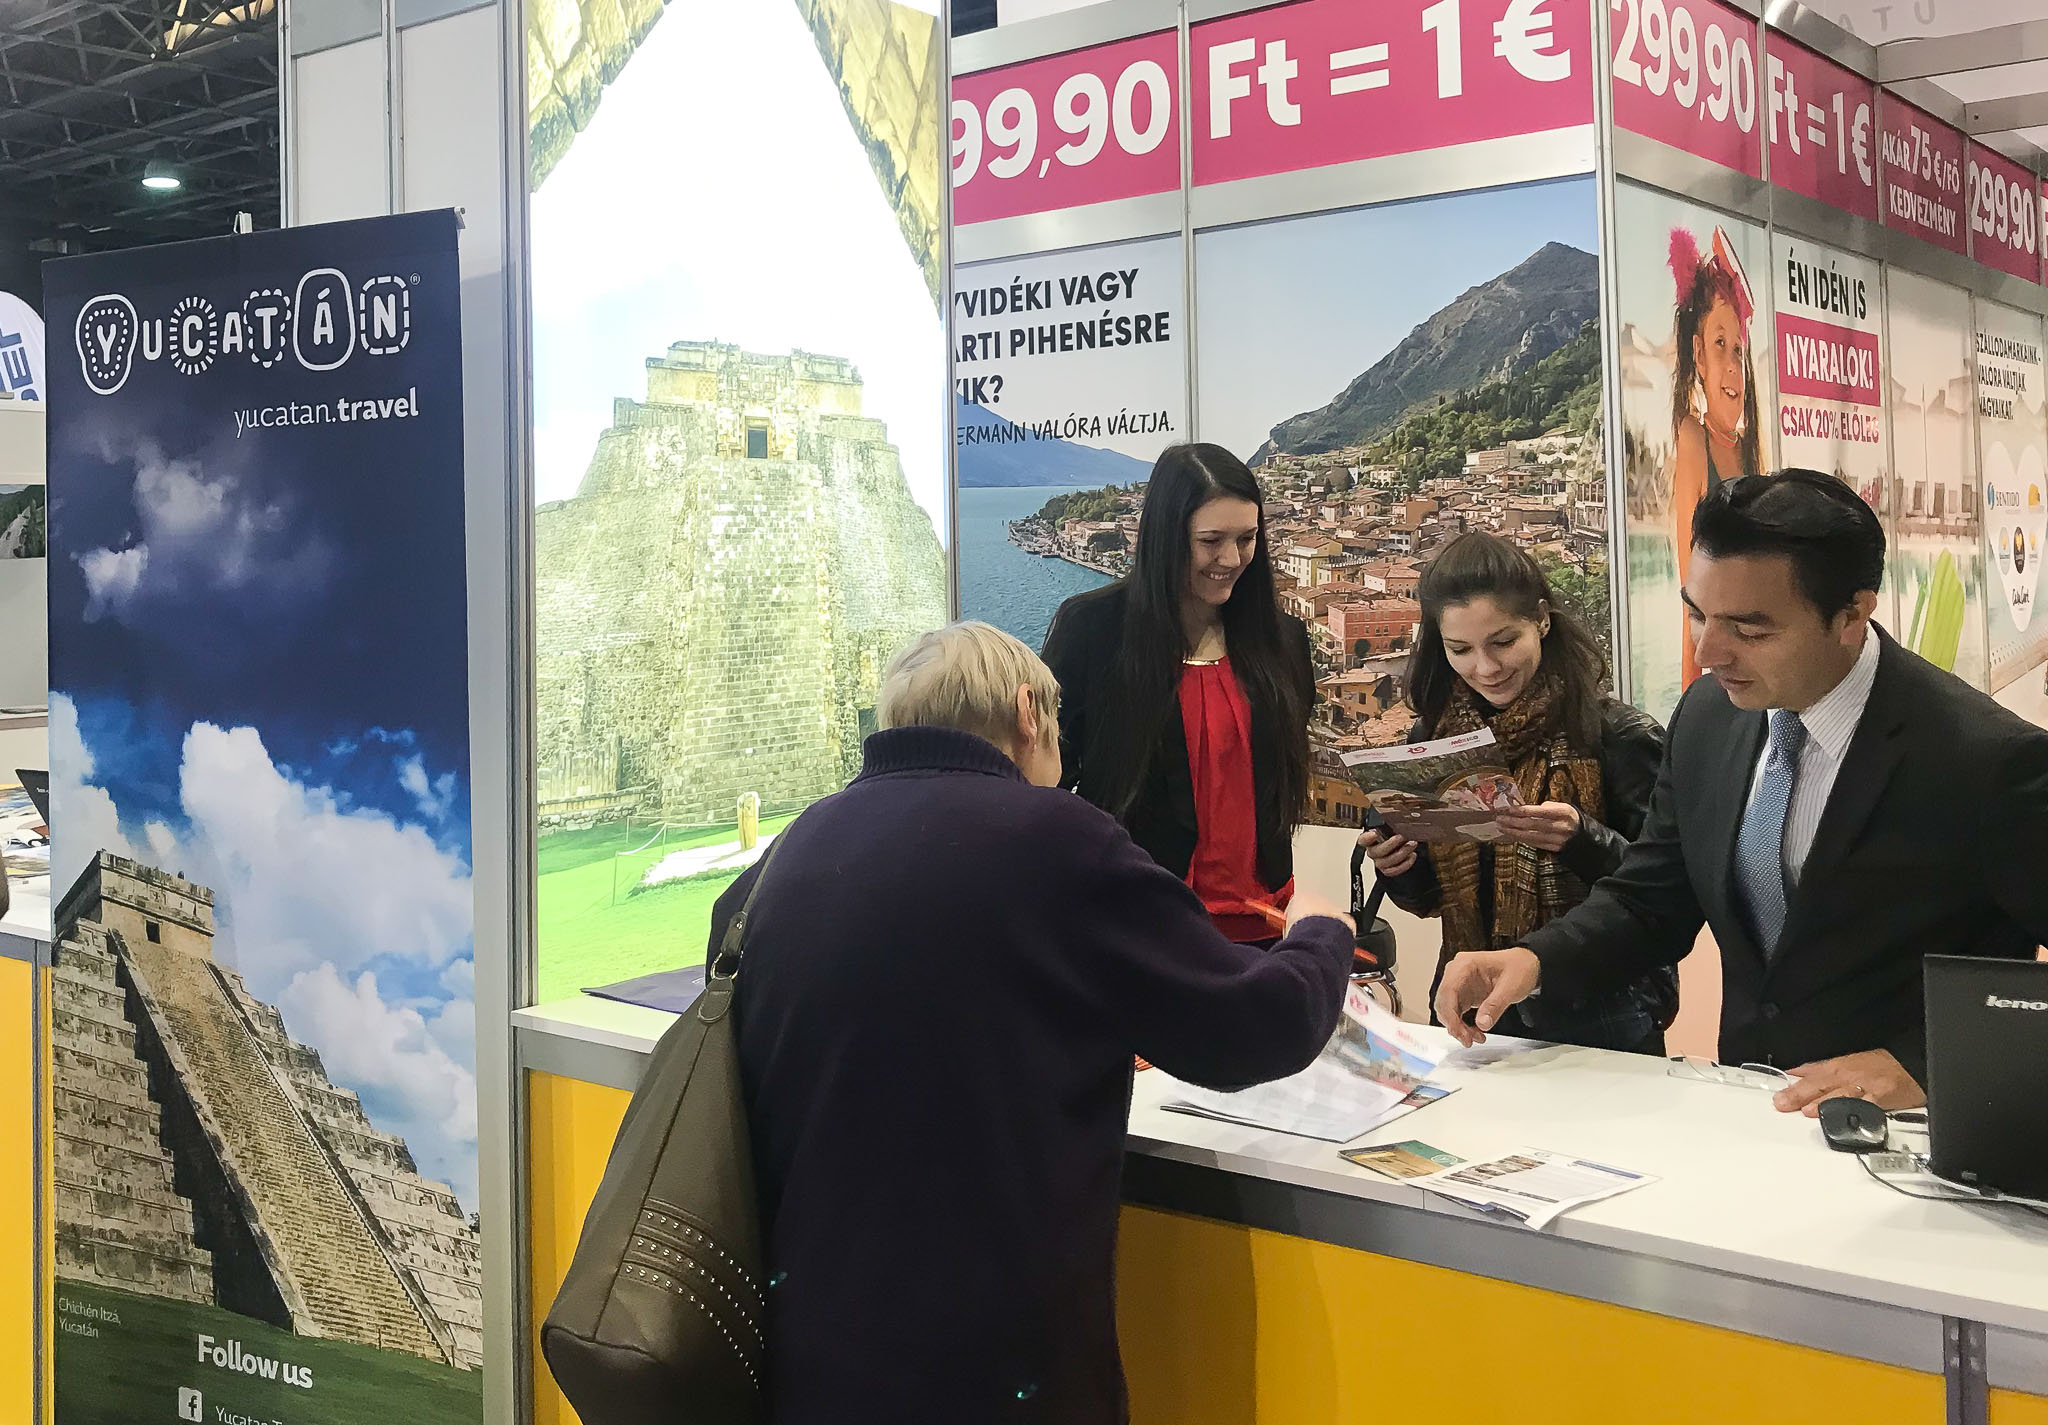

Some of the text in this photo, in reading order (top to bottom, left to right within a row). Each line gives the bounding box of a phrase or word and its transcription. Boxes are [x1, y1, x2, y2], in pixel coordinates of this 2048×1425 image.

[1208, 38, 1301, 139] Ft
[1422, 0, 1463, 99] 1
[1493, 0, 1571, 82] €
[1612, 0, 1755, 133] 299,90
[1769, 53, 1801, 155] Ft
[1832, 92, 1846, 174] 1
[1851, 102, 1872, 187] €
[1882, 130, 1910, 172] AKÁR
[1911, 125, 1931, 181] 75
[1890, 184, 1956, 237] KEDVEZMÉNY
[1970, 160, 2035, 255] 299,90
[1059, 268, 1139, 306] VAGY
[1788, 247, 1866, 320] ÉN IDÉN IS
[956, 309, 1170, 362] RTI PIHENÉSRE
[1785, 333, 1874, 390] NYARALOK!
[234, 387, 419, 438] yucatan.travel
[1032, 412, 1101, 441] VALÓRA
[1107, 408, 1175, 434] VÁLTJA.
[1781, 405, 1814, 437] CSAK
[1815, 409, 1839, 439] 20%
[59, 1297, 98, 1318] Chichén
[59, 1316, 98, 1338] Yucatán
[198, 1333, 313, 1389] Follow us
